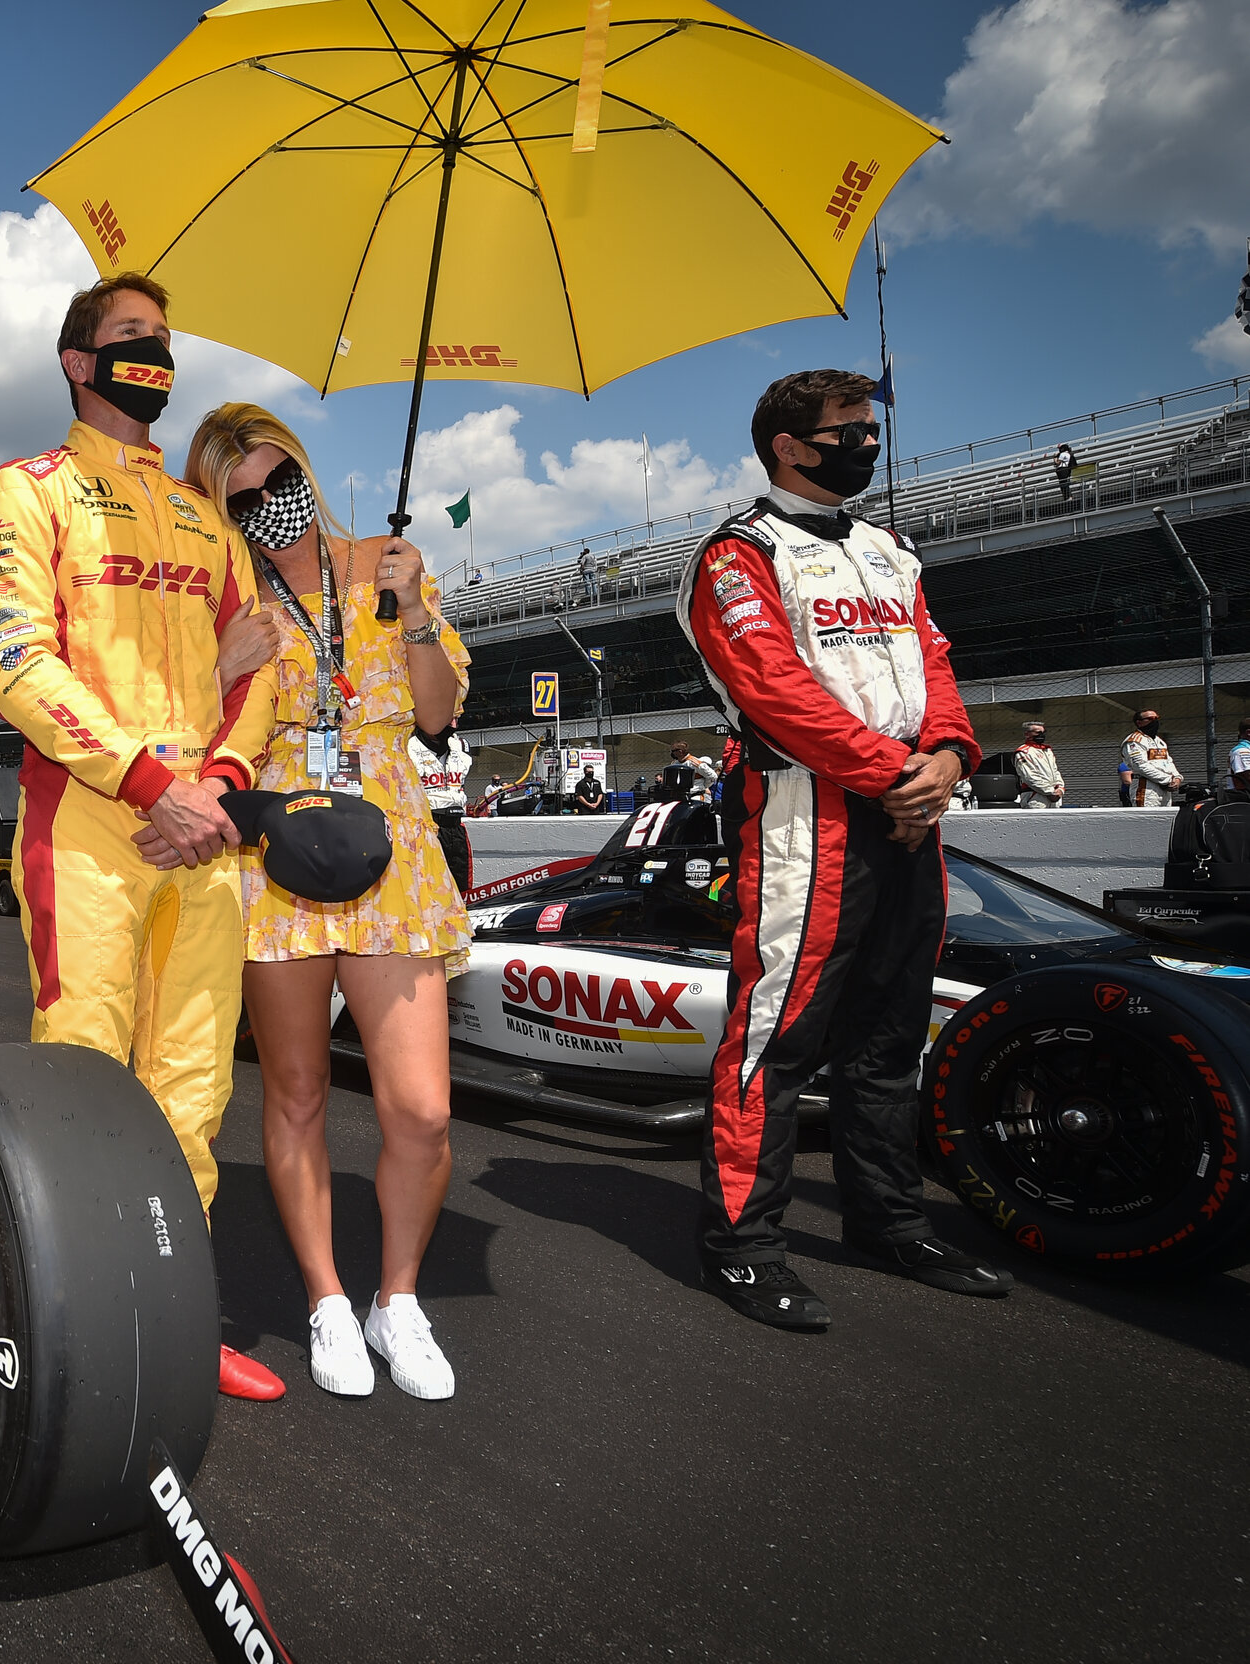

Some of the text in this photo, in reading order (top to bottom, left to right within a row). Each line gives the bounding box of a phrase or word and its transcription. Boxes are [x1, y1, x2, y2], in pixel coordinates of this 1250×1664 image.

[133, 456, 162, 471] DHL
[72, 496, 136, 513] HONDA
[95, 554, 213, 598] DHL
[322, 568, 331, 650] NTT INDYCAR SERIES
[812, 597, 914, 628] SONAX
[820, 633, 849, 650] MADE
[535, 680, 556, 709] 27
[291, 798, 327, 810] DHL
[625, 800, 681, 848] 21
[469, 868, 550, 902] U.S. AIR FORCE
[1138, 906, 1202, 916] Ed Carpenter
[501, 958, 697, 1031] SONAX
[506, 1016, 534, 1039] MADE
[538, 1029, 551, 1044] IN
[555, 1033, 625, 1055] GERMANY
[932, 999, 1010, 1156] Firestone
[1168, 1033, 1238, 1221] FIREHAWK
[1087, 1194, 1153, 1215] RACING
[149, 1465, 223, 1588] DMG
